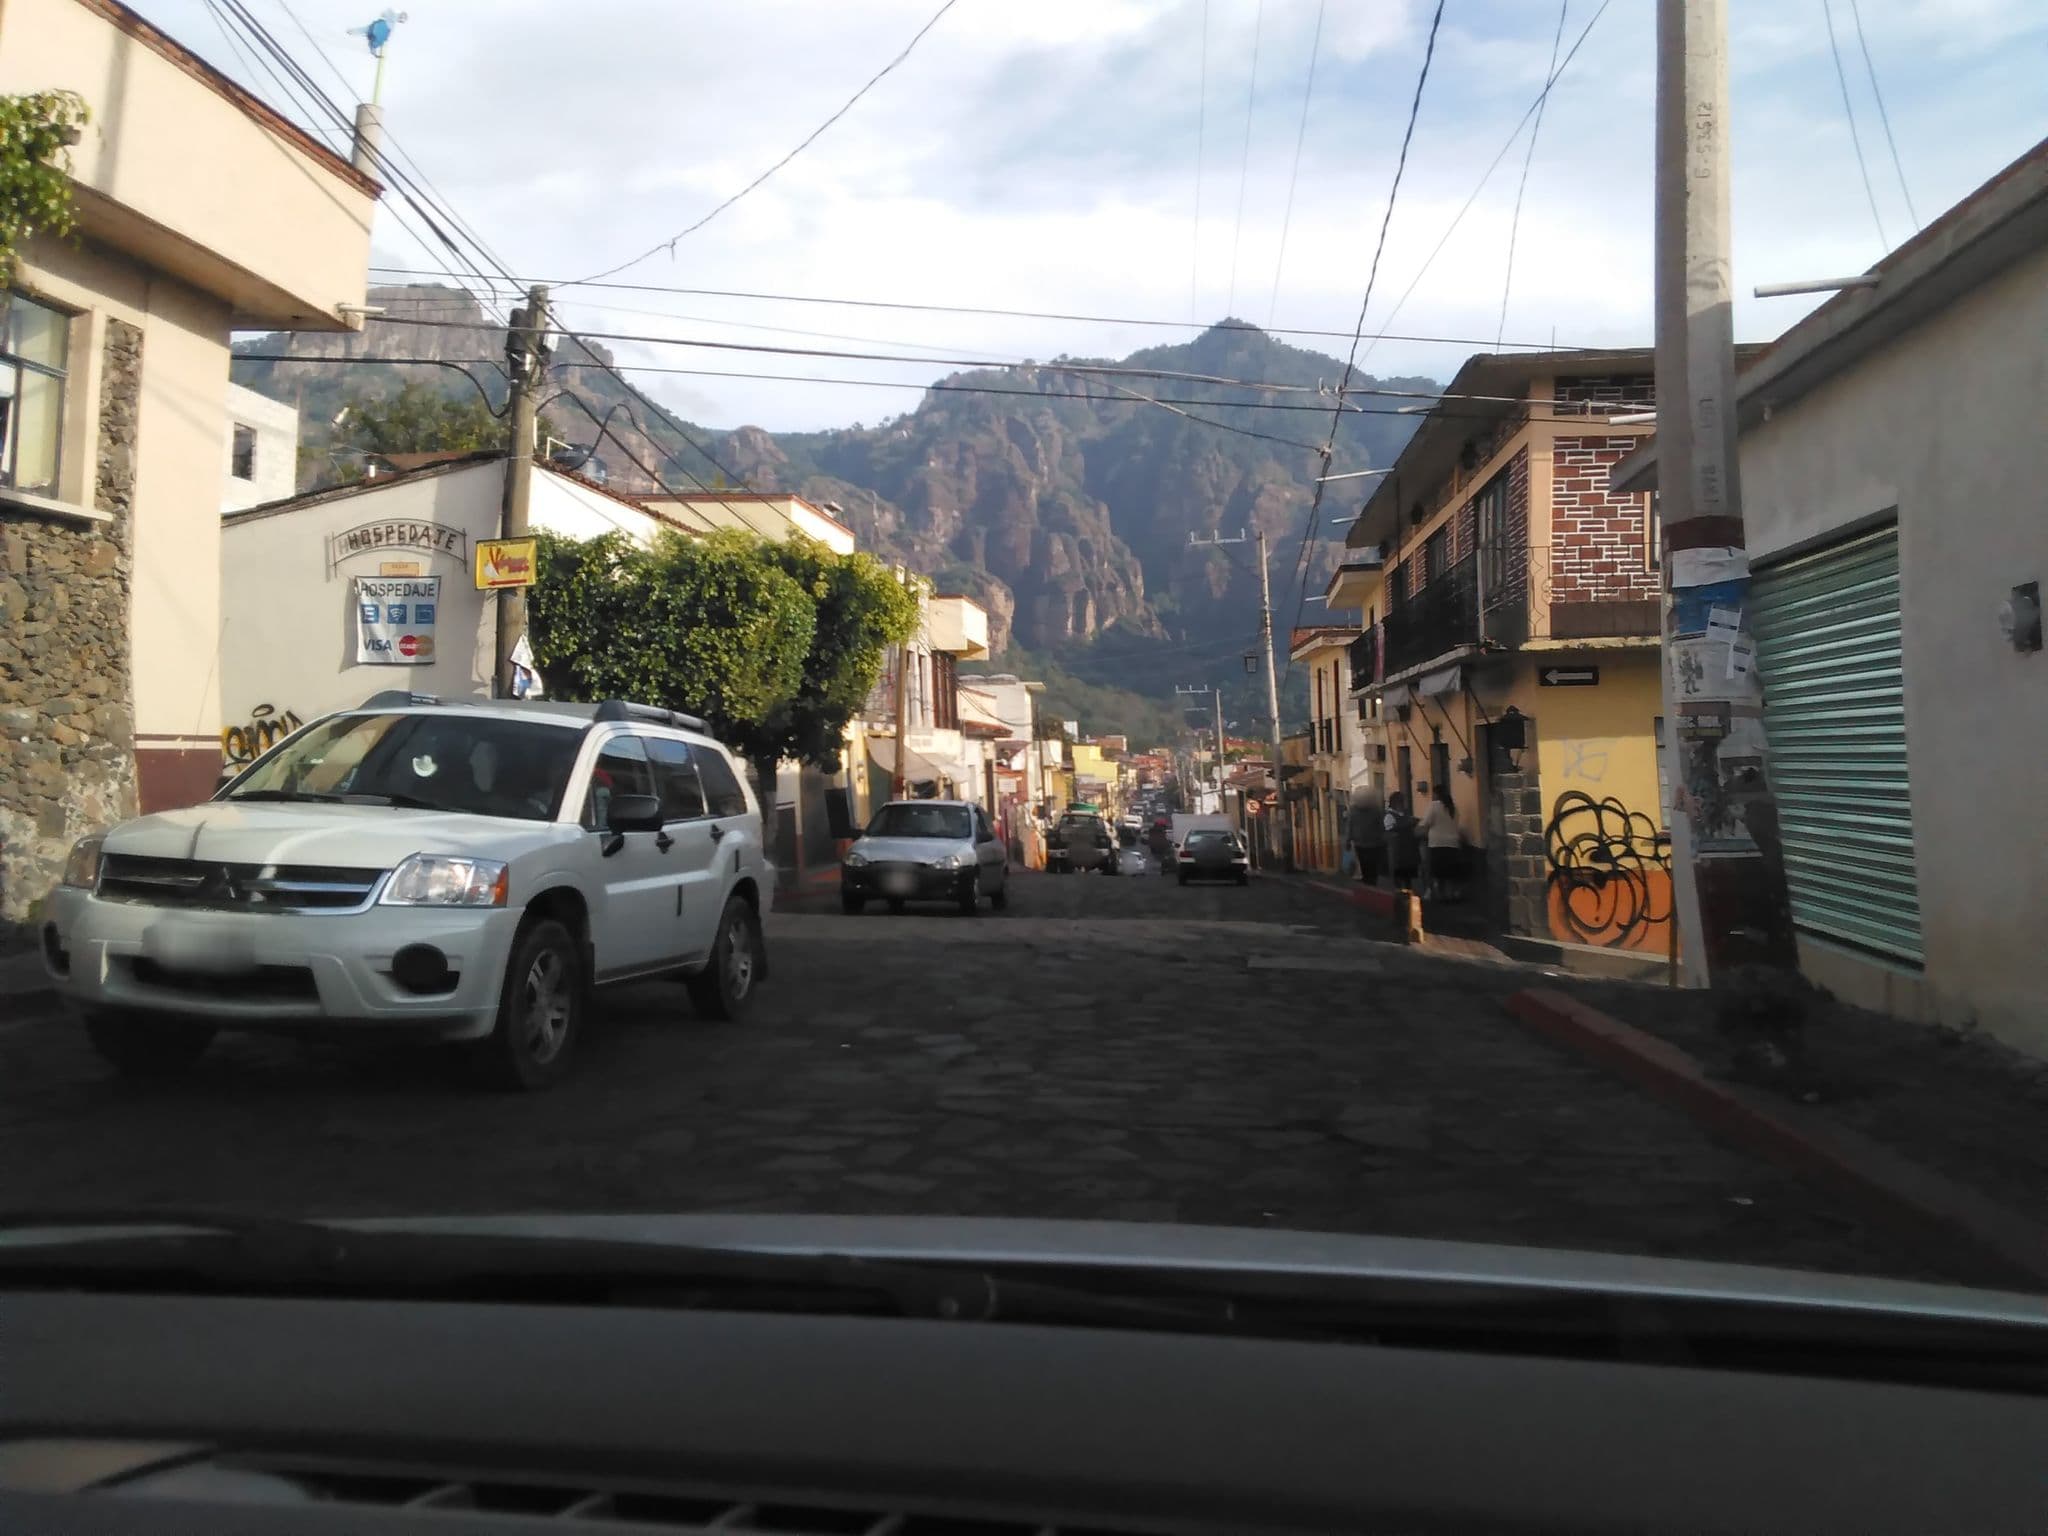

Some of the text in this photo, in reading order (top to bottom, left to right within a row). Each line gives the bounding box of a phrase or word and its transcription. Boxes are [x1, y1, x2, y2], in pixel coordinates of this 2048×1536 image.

[347, 524, 457, 550] HOSPEDAJE
[361, 583, 435, 597] HOSPEDAJE
[364, 639, 393, 651] VISA
